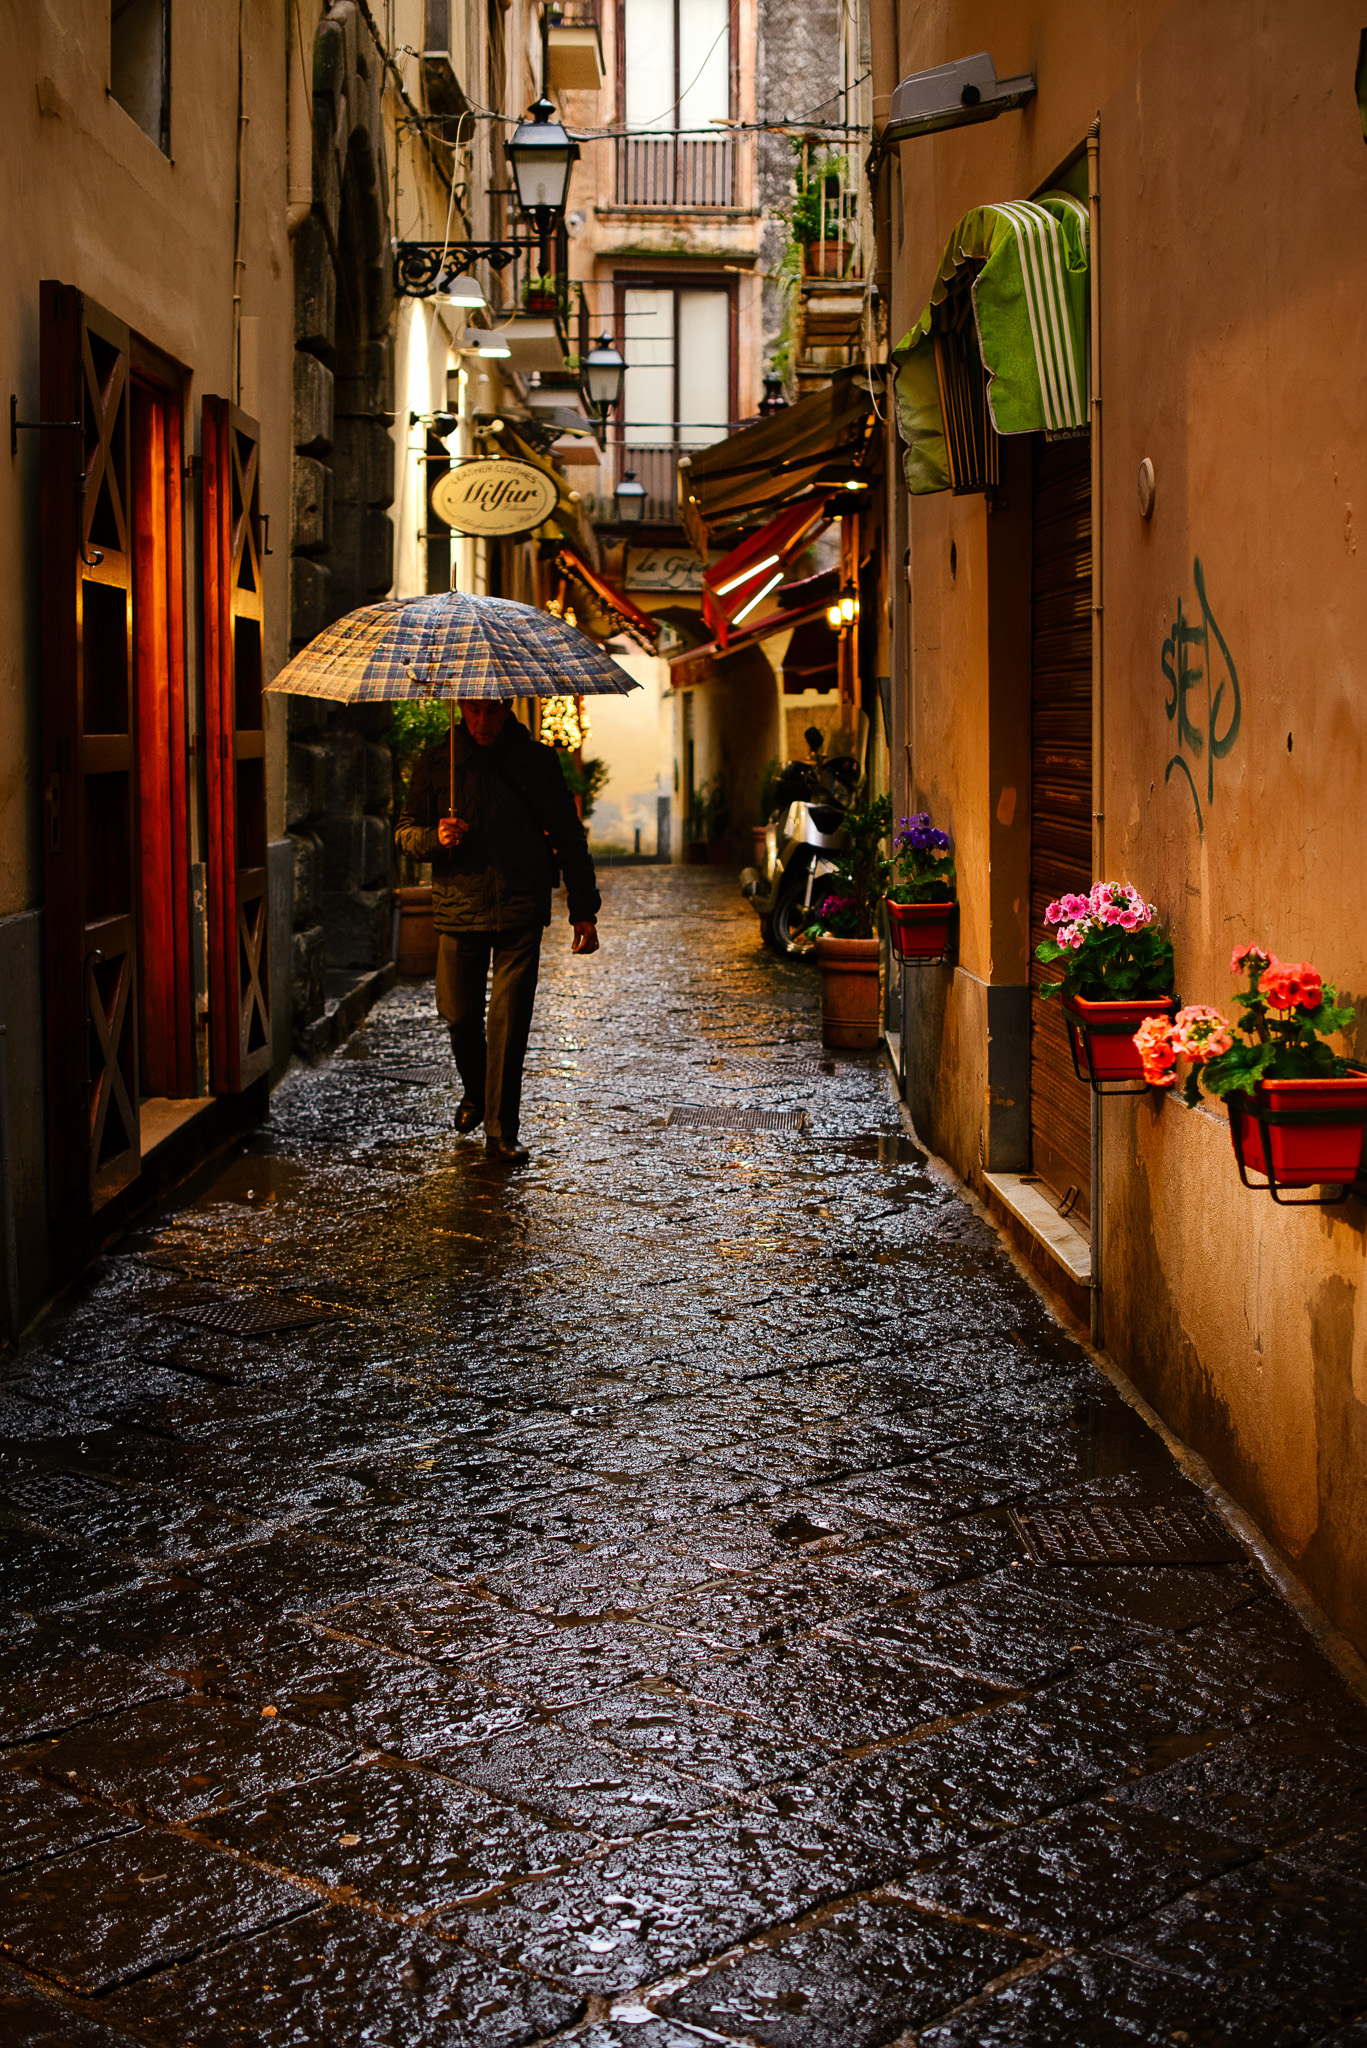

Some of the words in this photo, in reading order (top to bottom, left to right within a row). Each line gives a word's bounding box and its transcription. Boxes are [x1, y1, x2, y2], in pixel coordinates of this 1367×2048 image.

[451, 464, 493, 484] LEATHER
[495, 464, 538, 484] CLOTHES
[447, 479, 538, 512] Milfur
